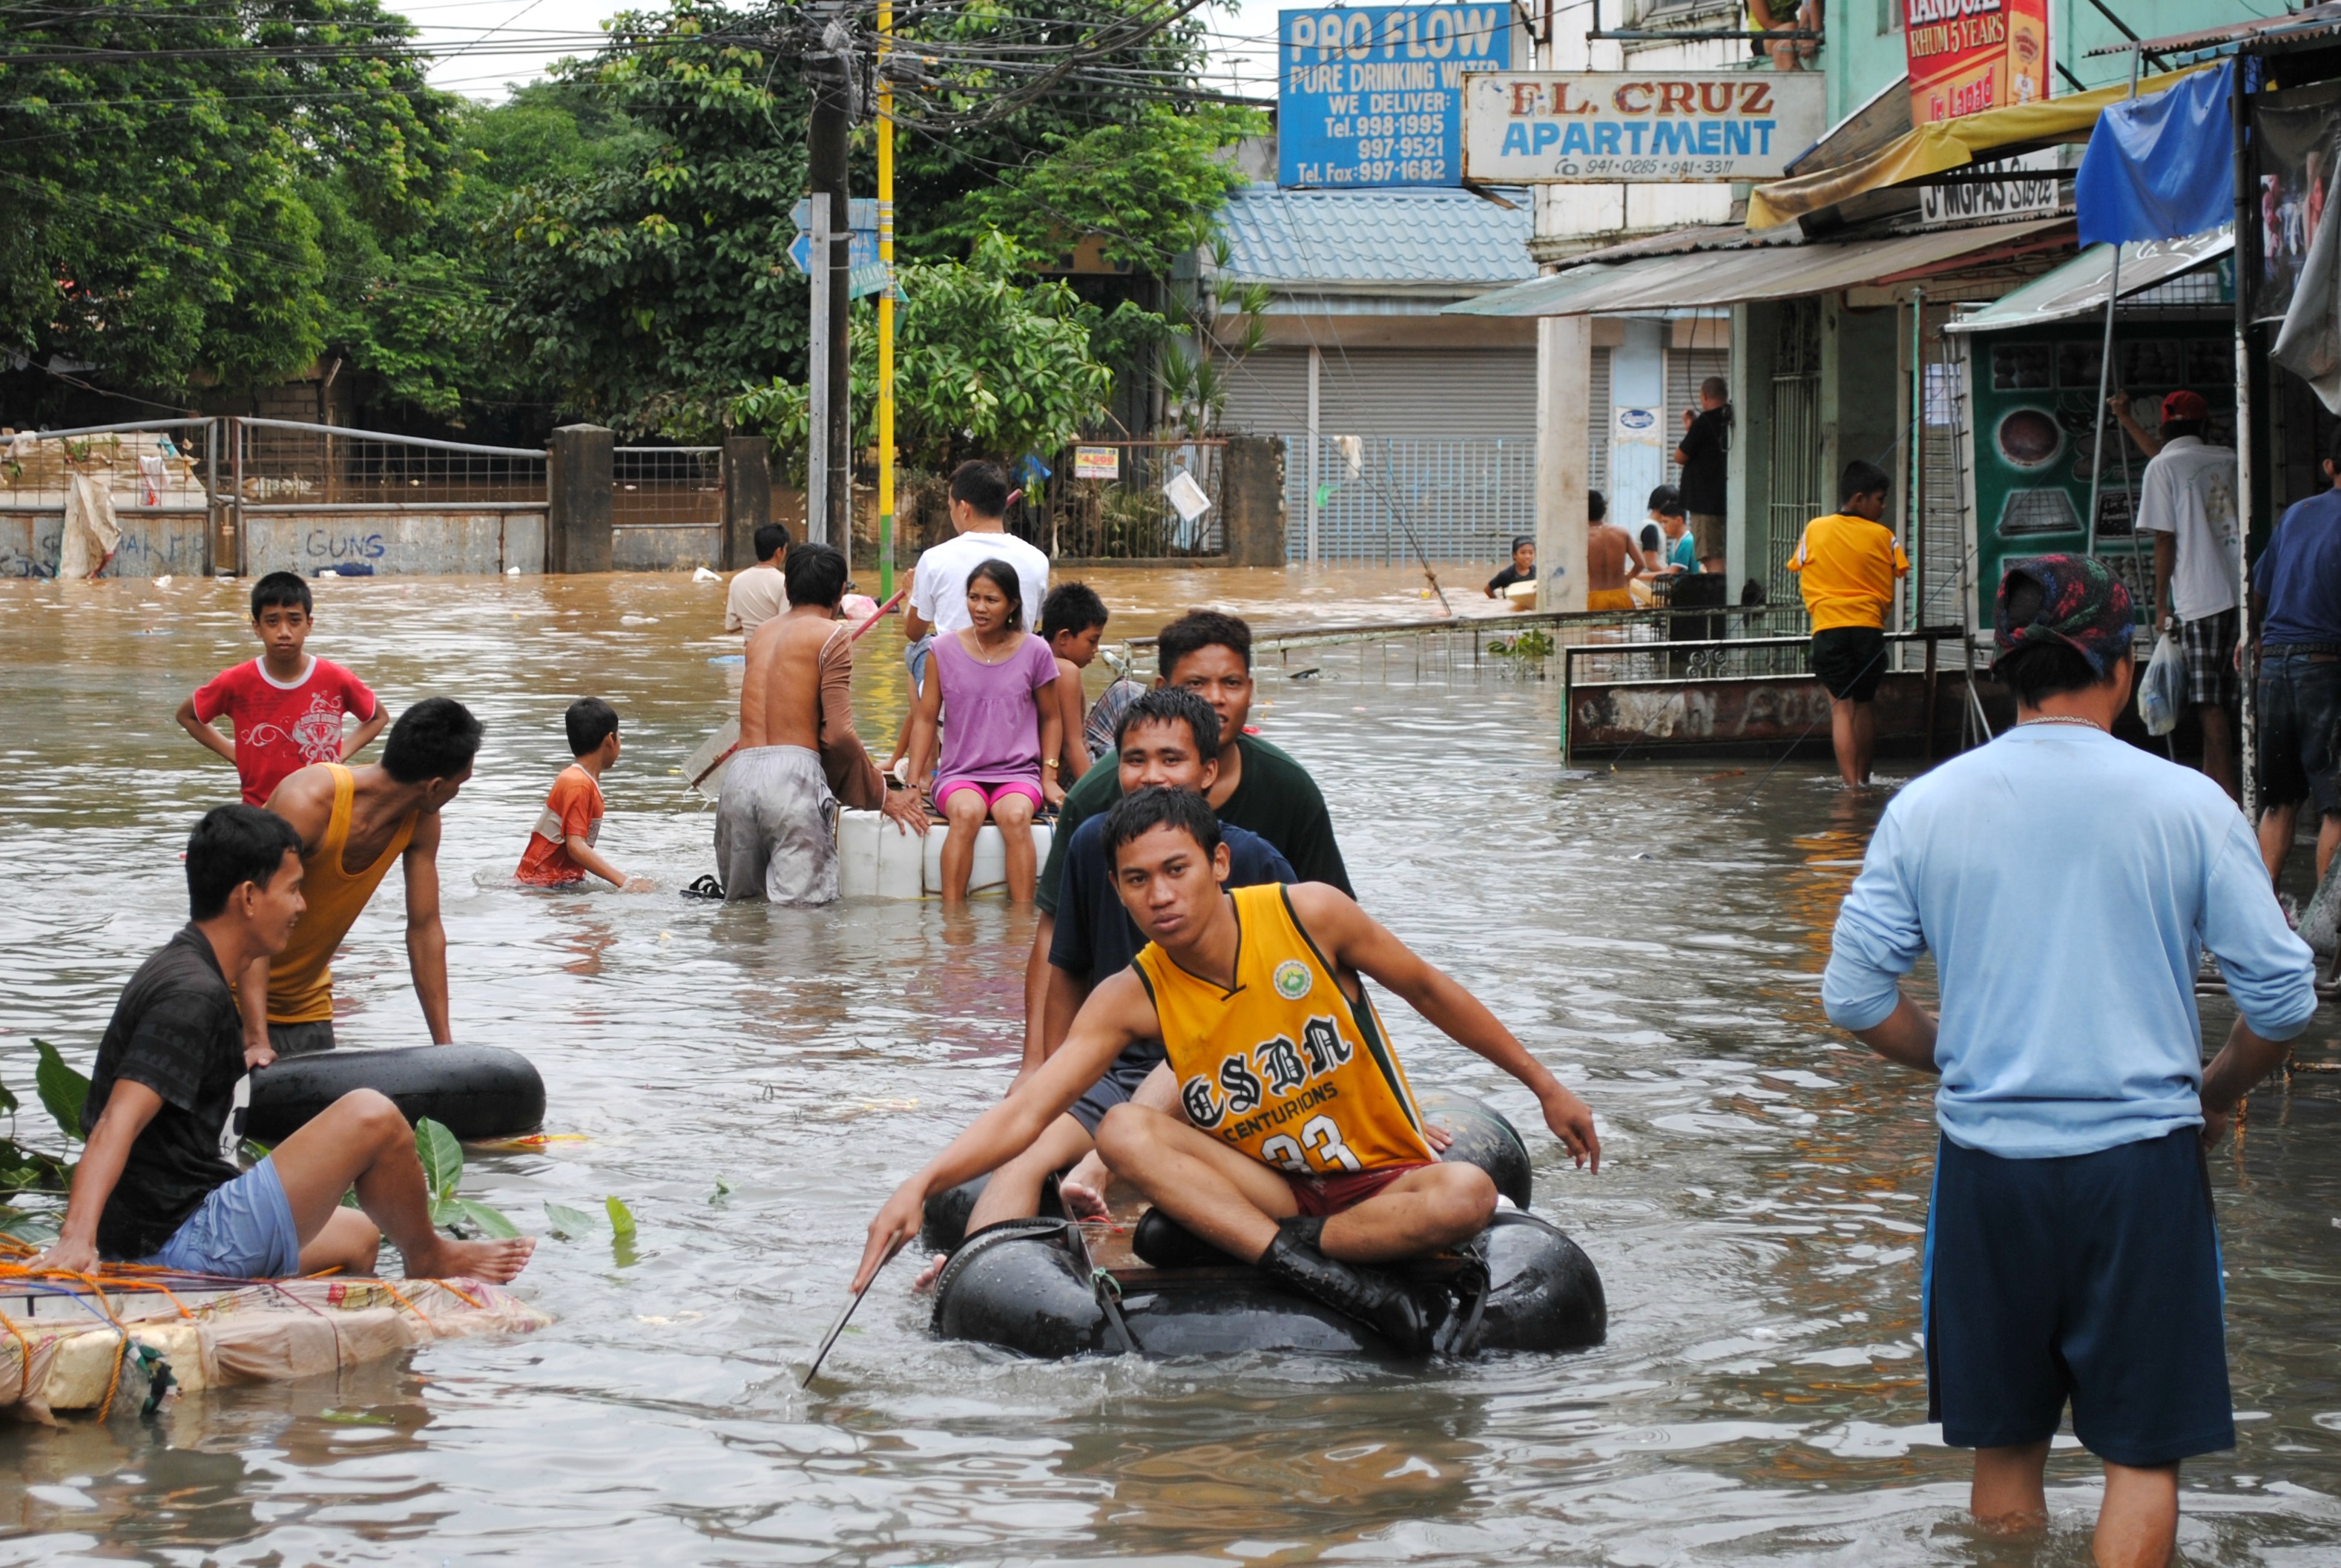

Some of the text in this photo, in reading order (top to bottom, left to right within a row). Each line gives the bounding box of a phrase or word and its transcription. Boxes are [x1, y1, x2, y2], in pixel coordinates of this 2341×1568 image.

[1909, 0, 2001, 24] TAND
[1291, 7, 1497, 62] PRO FLOW
[1909, 24, 1949, 58] RHUM
[1950, 21, 1960, 54] 5
[1960, 13, 2005, 49] YEARS
[1290, 65, 1343, 94] PURE
[1350, 61, 1435, 92] DRINKING
[1328, 91, 1451, 115] WE DELIVER:
[1612, 81, 1777, 117] CRUZ
[1500, 119, 1777, 157] APARTMENT
[306, 529, 385, 559] GUNS
[1222, 1081, 1338, 1143] CENTURIONS
